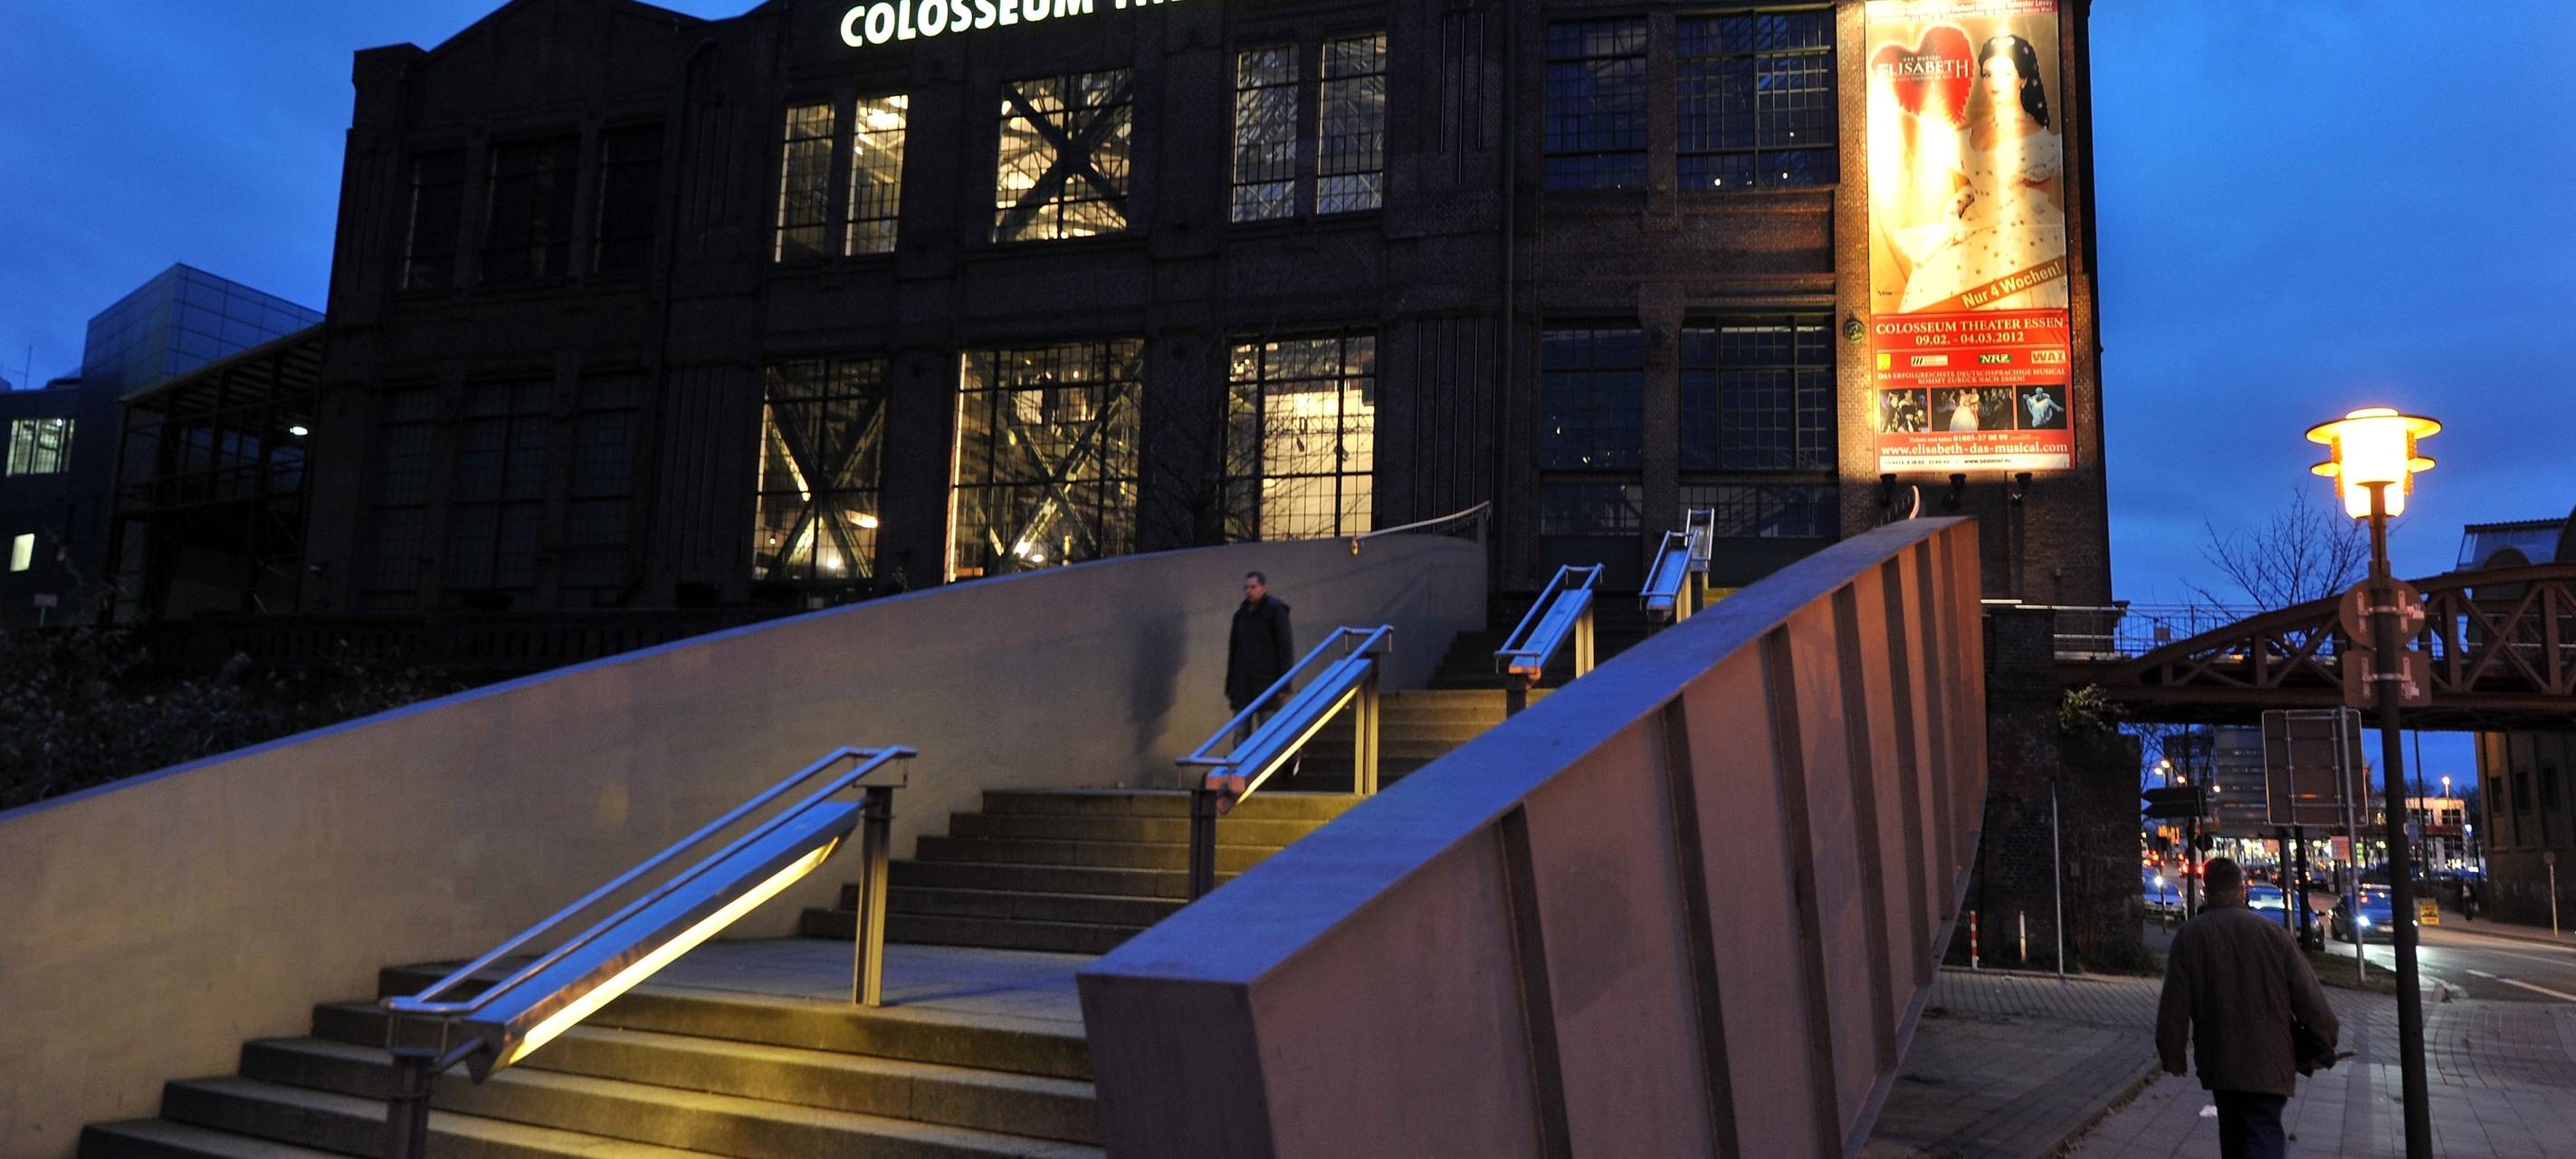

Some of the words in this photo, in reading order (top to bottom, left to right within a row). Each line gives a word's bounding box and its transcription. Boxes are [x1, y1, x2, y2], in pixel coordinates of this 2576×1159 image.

[1961, 291, 1989, 309] Nur
[1990, 284, 1999, 297] 4
[1999, 261, 2062, 293] Wochen!
[1875, 321, 1957, 334] COLOSSEUM
[1960, 318, 2021, 331] THEATER
[2024, 317, 2064, 329] ESSEN
[1915, 334, 1951, 345] 09.02.
[1961, 331, 2025, 344] 04.03.2012
[1980, 354, 2011, 363] NRZ
[2032, 368, 2065, 376] MUSICAL
[1881, 441, 2067, 455] www.elisabeth-das-musical.com
